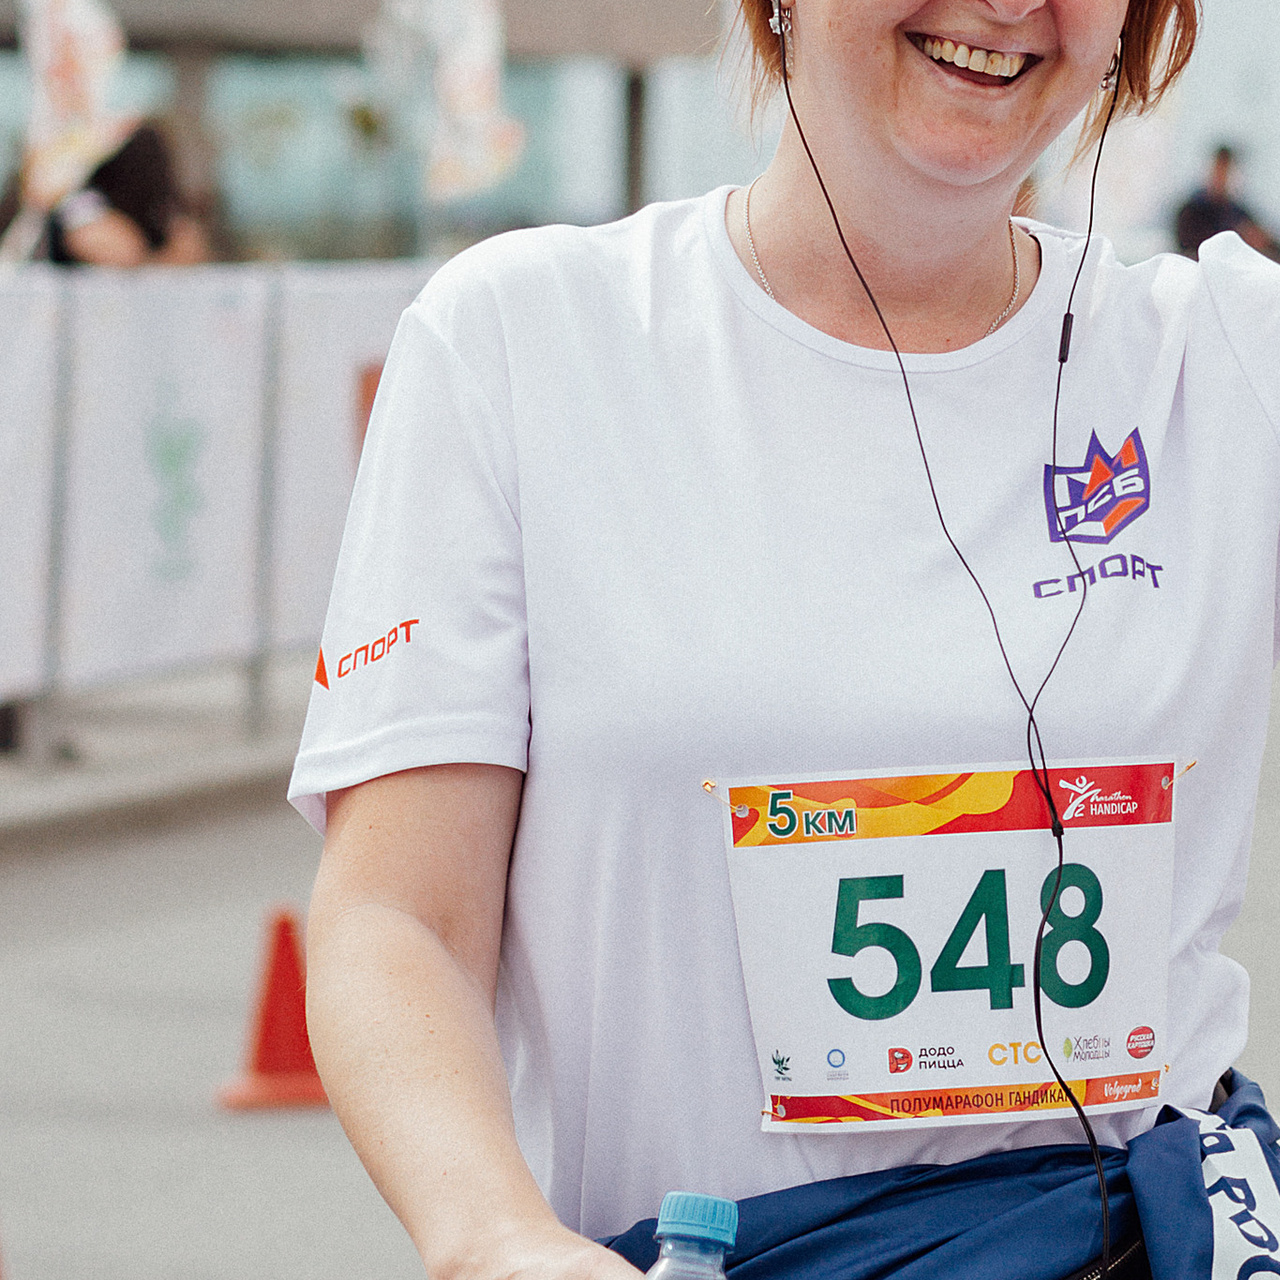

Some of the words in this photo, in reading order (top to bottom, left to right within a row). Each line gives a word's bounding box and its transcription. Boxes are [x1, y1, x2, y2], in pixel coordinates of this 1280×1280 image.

[1032, 553, 1164, 599] СПОРТ
[337, 619, 420, 679] СПОРТ
[766, 790, 798, 838] 5
[1089, 801, 1139, 816] HANDICAP
[827, 862, 1110, 1021] 548
[918, 1046, 955, 1058] ДОДО
[918, 1058, 965, 1070] ПИЦЦА
[987, 1040, 1043, 1066] СТС
[889, 1092, 1004, 1114] ПОЛУМАРАФОН
